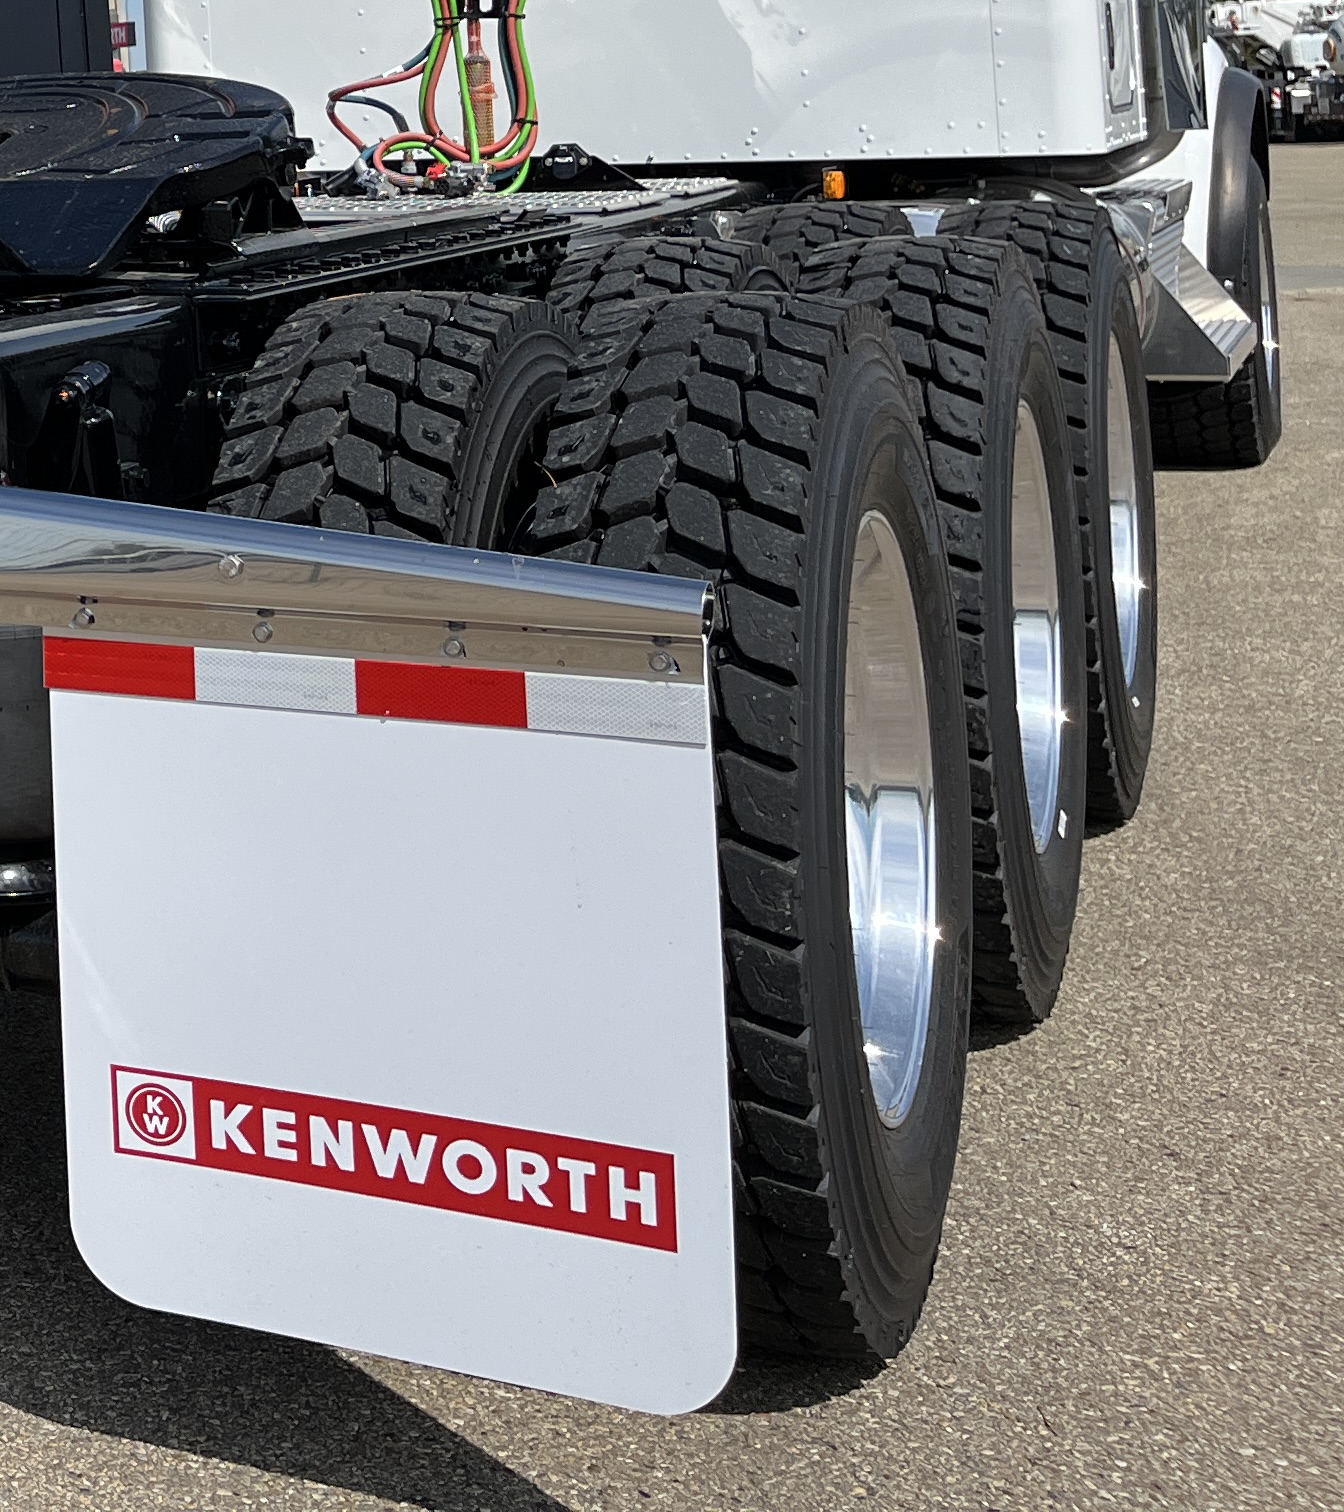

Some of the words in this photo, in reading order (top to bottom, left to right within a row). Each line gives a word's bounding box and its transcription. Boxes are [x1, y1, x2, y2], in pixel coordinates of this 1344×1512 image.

[145, 1093, 164, 1116] K
[142, 1113, 170, 1138] W
[209, 1097, 659, 1228] KENWORTH
